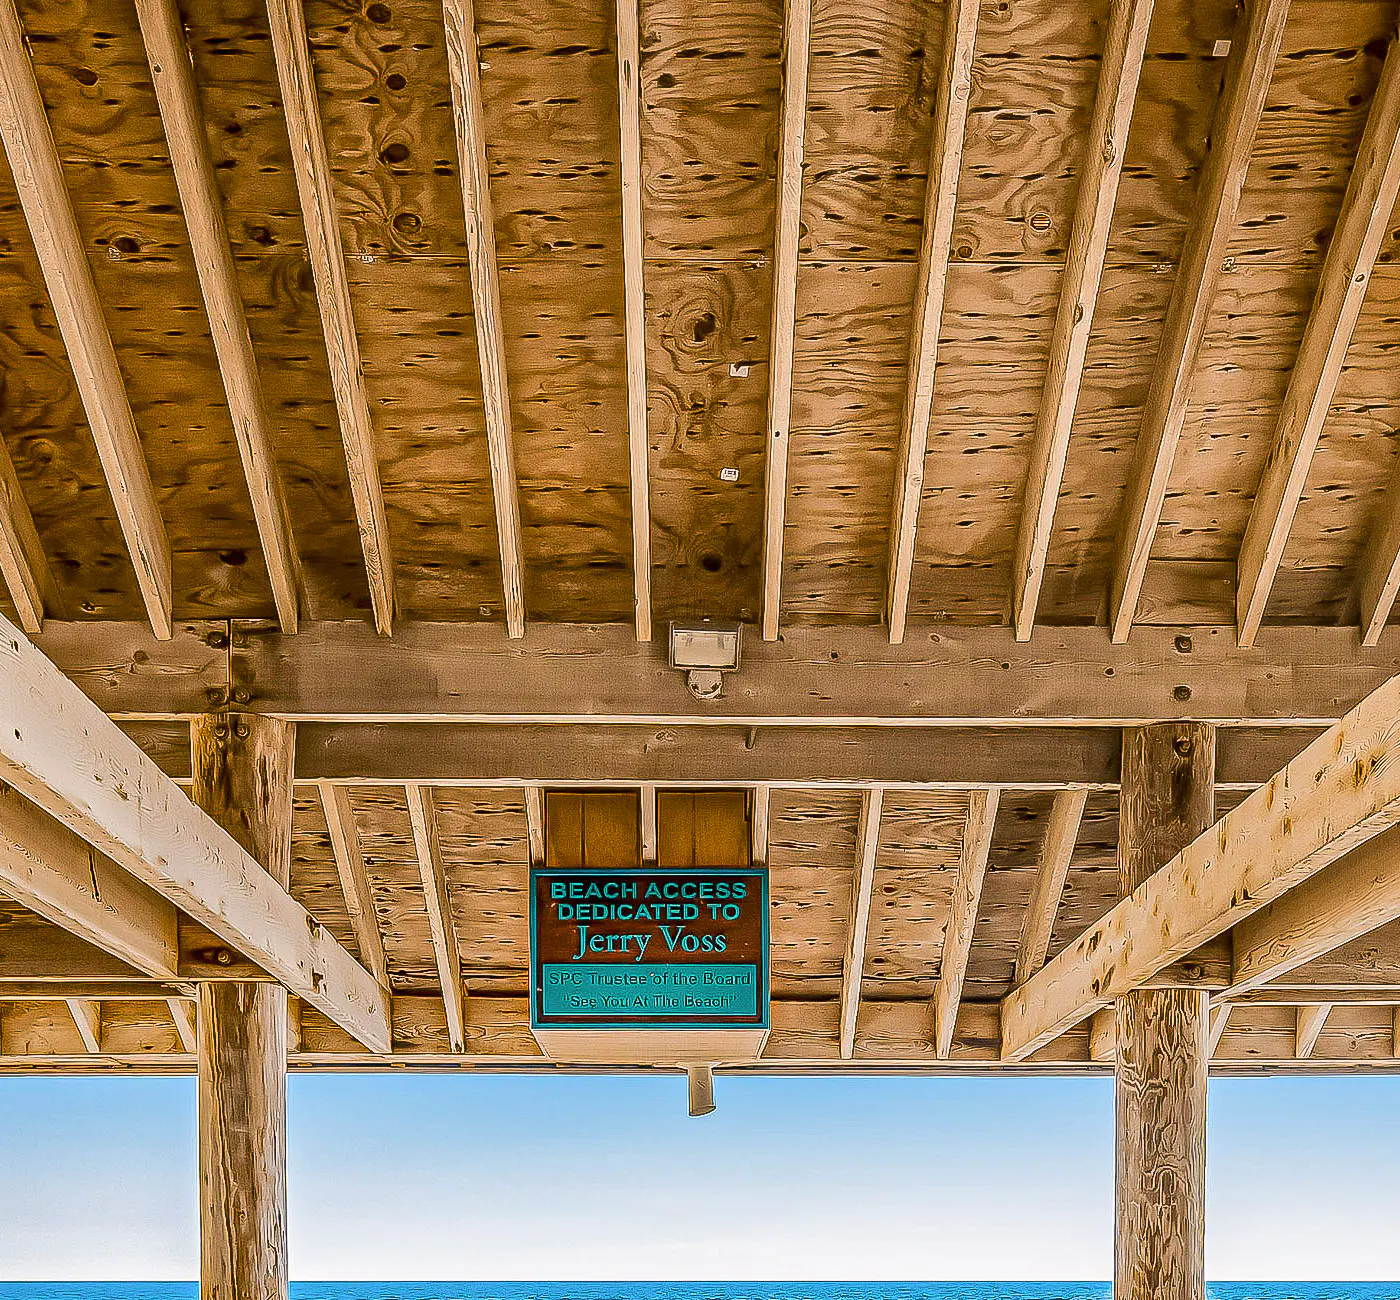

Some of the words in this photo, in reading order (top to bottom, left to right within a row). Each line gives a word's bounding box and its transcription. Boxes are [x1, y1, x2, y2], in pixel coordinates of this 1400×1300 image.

[551, 882, 637, 899] BEACH
[644, 882, 747, 899] ACCESS
[558, 903, 699, 921] DEDICATED
[707, 903, 740, 921] TO
[572, 925, 652, 962] Jerry
[658, 925, 727, 953] Voss
[549, 972, 583, 985] SPC
[589, 972, 647, 985] Trustee
[652, 972, 669, 985] of
[673, 972, 697, 985] the
[703, 972, 751, 985] Board
[601, 994, 629, 1007] You
[633, 994, 649, 1007] At
[653, 994, 679, 1007] The
